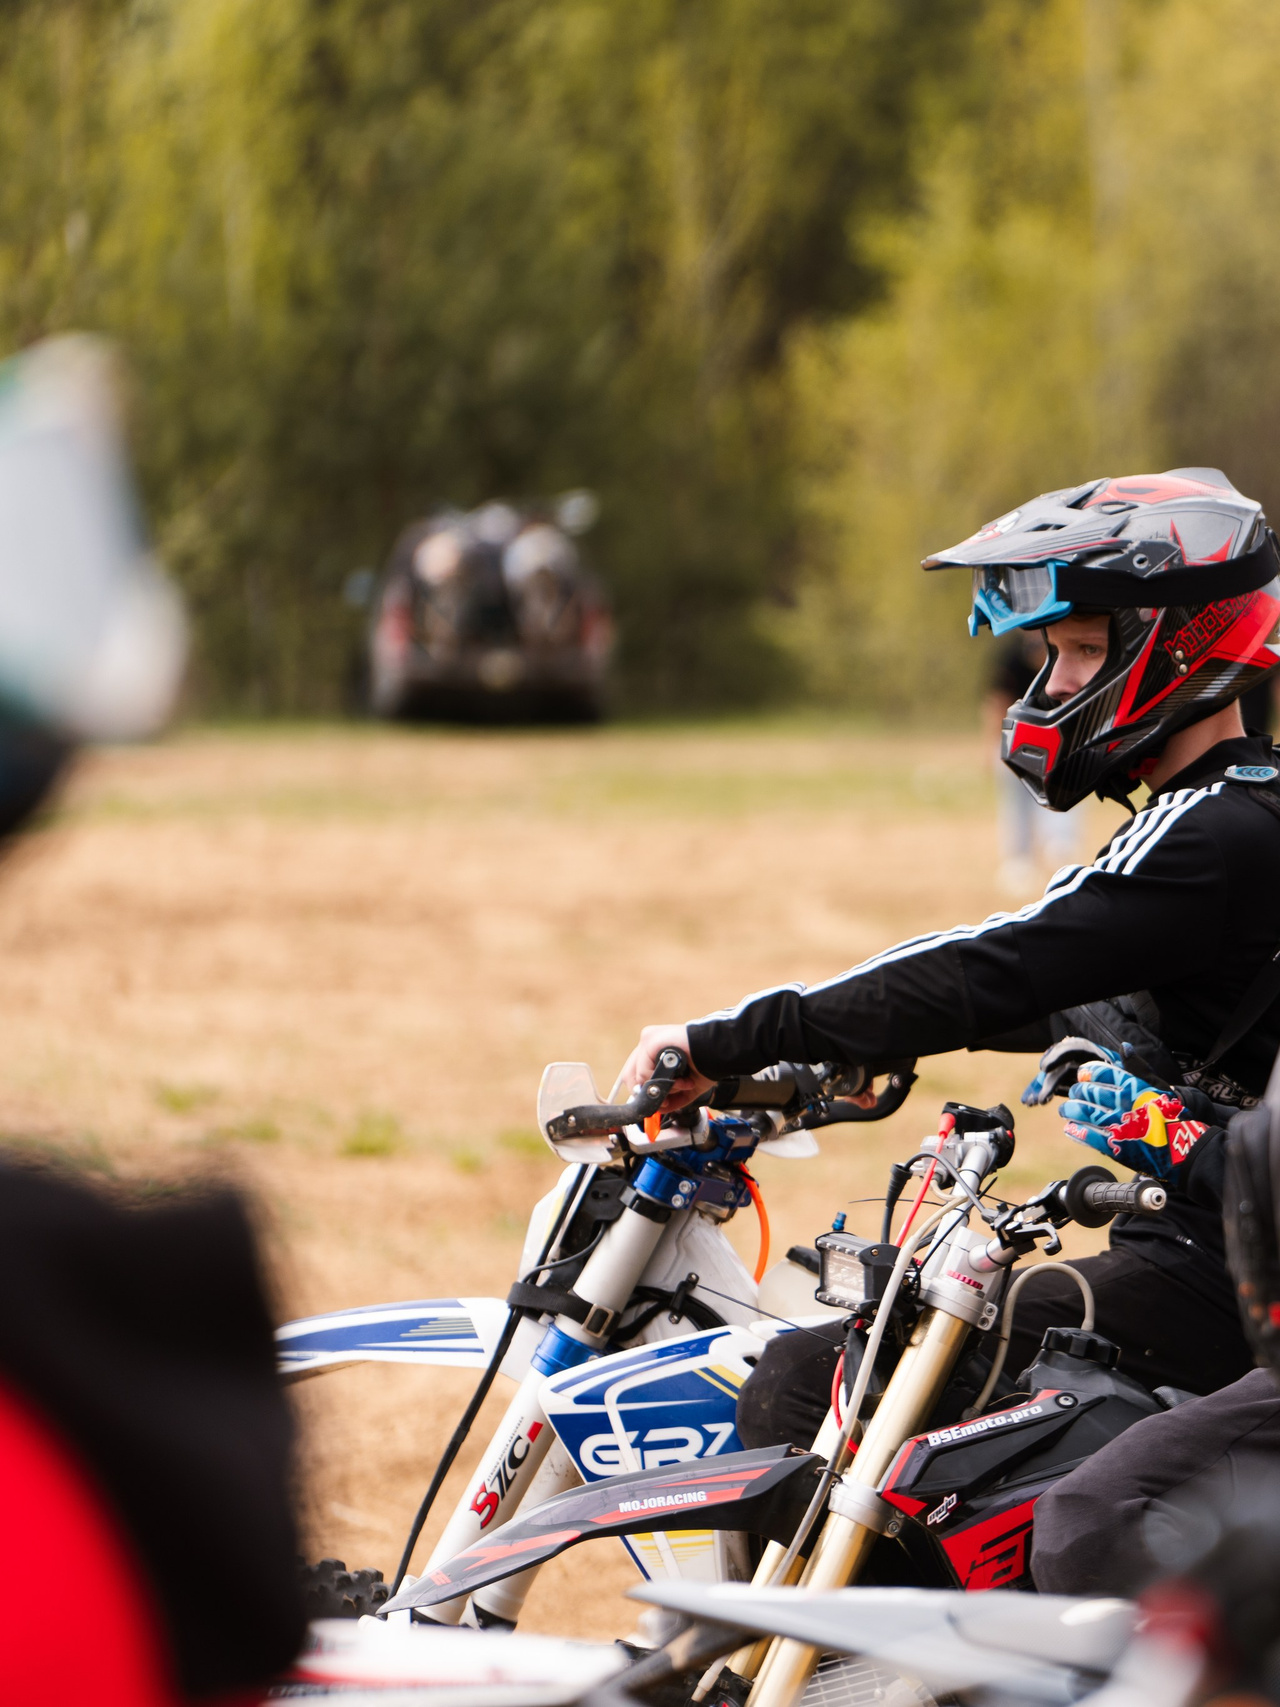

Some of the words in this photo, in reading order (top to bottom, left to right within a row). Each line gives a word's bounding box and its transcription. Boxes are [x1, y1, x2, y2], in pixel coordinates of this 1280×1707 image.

[927, 1405, 1043, 1447] BSEmoto.pro
[579, 1422, 735, 1476] GR7
[618, 1490, 707, 1513] MOJORACING
